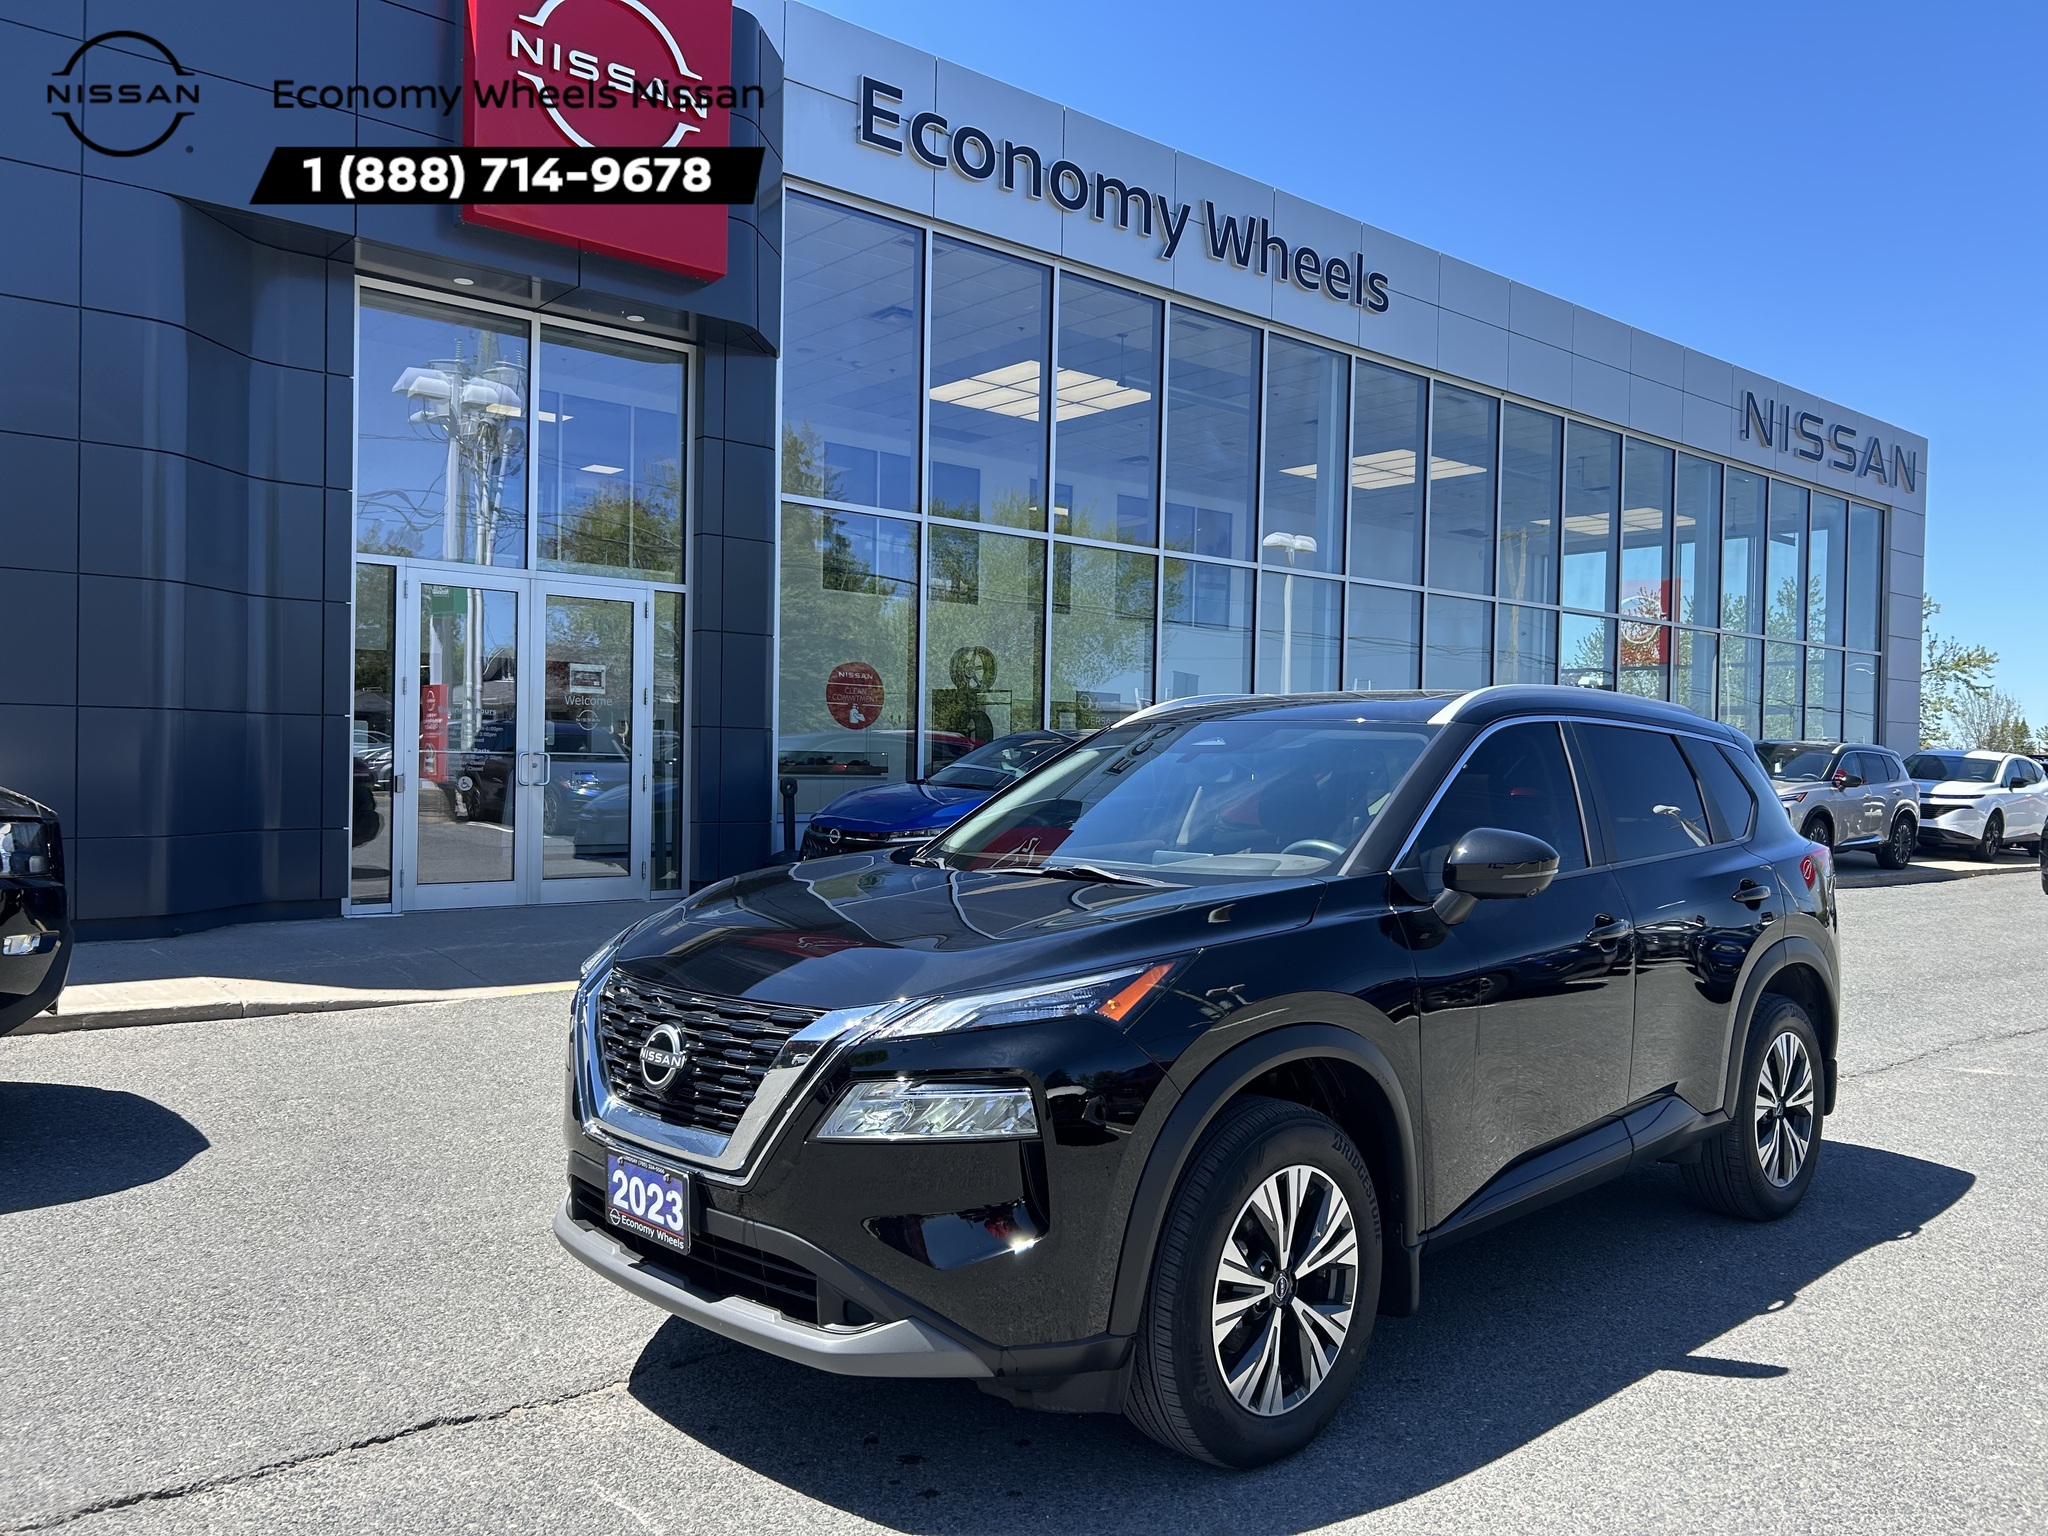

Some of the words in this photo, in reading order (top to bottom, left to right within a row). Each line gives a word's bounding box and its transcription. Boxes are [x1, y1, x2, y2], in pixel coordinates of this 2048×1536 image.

[510, 28, 708, 120] NISSAN
[857, 74, 1191, 262] Economy
[1204, 198, 1391, 315] Wheels
[1740, 389, 1917, 493] NISSAN
[838, 671, 873, 680] NISSAN
[832, 693, 879, 703] COMMITMENT
[844, 686, 867, 695] CLEAN
[564, 695, 613, 706] Welcome
[437, 706, 473, 714] Busine
[1084, 716, 1111, 725] VERSA
[639, 1047, 682, 1067] NISSAN
[612, 1169, 684, 1232] 2023
[621, 1214, 656, 1238] Economy
[656, 1229, 685, 1250] Wheels
